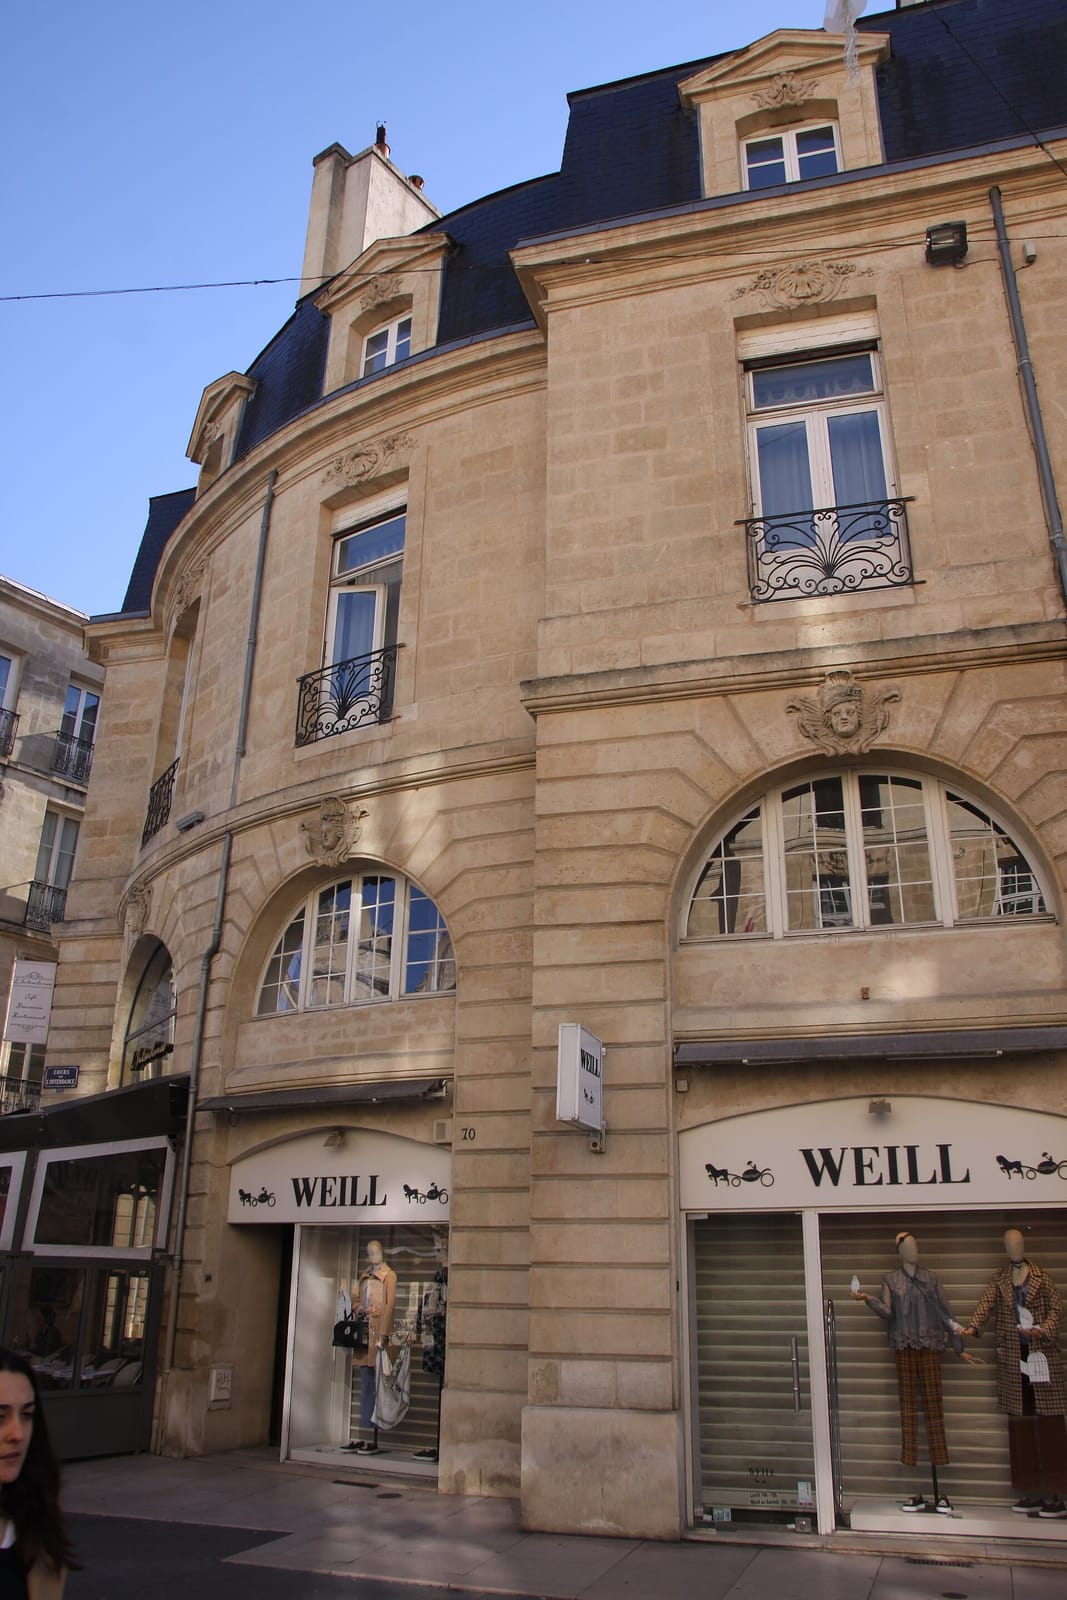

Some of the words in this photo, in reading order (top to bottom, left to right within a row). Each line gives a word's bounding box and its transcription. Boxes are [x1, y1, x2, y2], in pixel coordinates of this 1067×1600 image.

[580, 1047, 601, 1078] WEILL
[461, 1127, 476, 1141] 70
[799, 1143, 970, 1187] WEILL
[291, 1174, 387, 1208] WEILL
